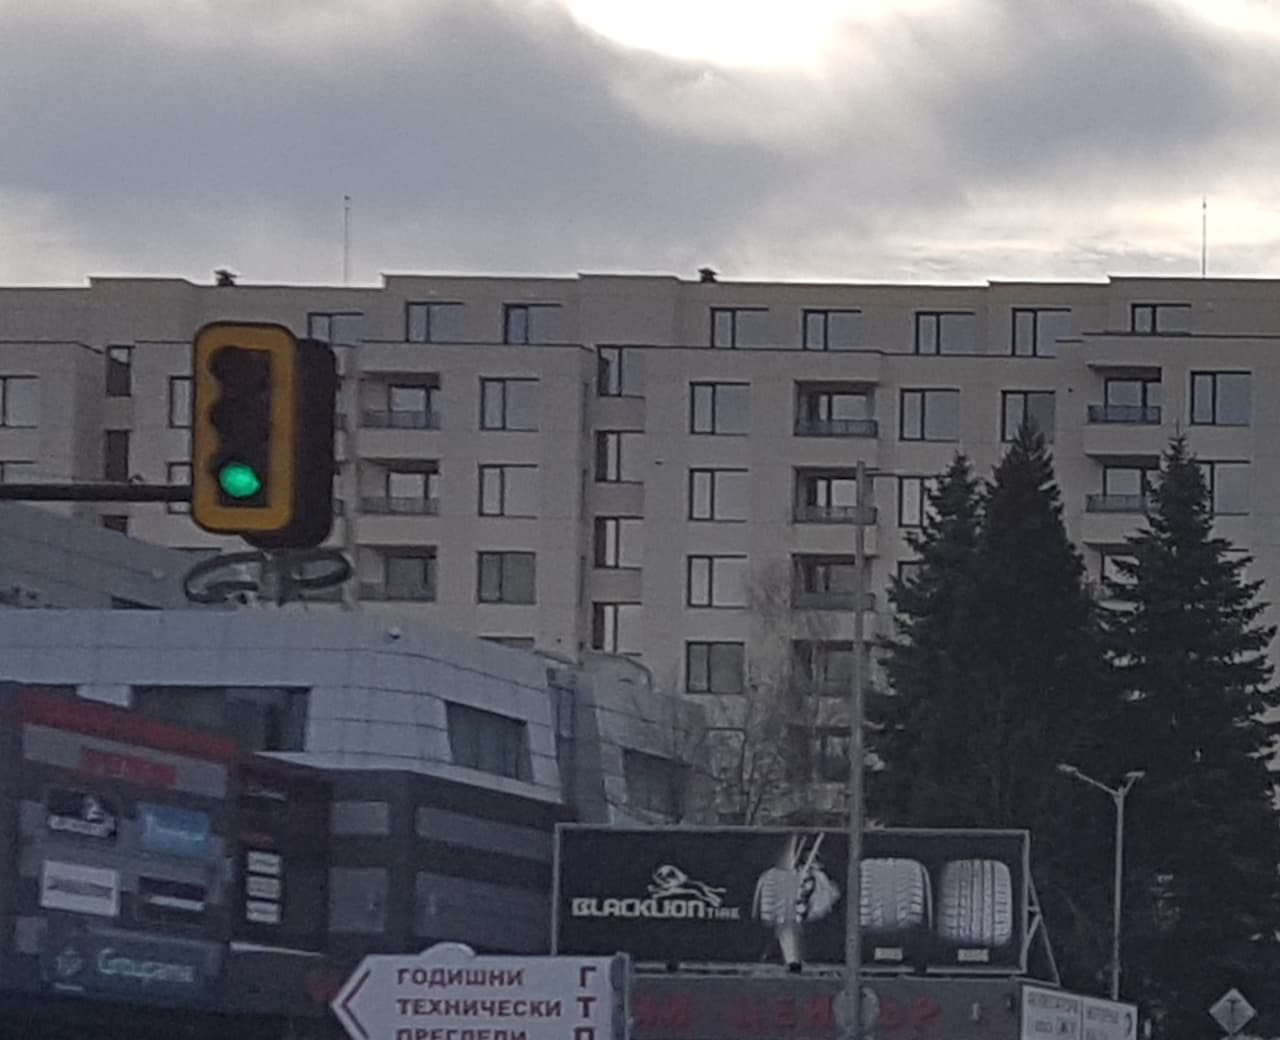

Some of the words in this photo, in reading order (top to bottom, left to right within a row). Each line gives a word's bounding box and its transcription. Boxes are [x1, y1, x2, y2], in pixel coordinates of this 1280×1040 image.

[571, 898, 705, 918] BLACKLION
[397, 967, 525, 988] ГОДИШНИ
[579, 965, 597, 988] Г
[397, 998, 563, 1018] ТЕХНИЧЕСКИ
[576, 996, 598, 1018] Т
